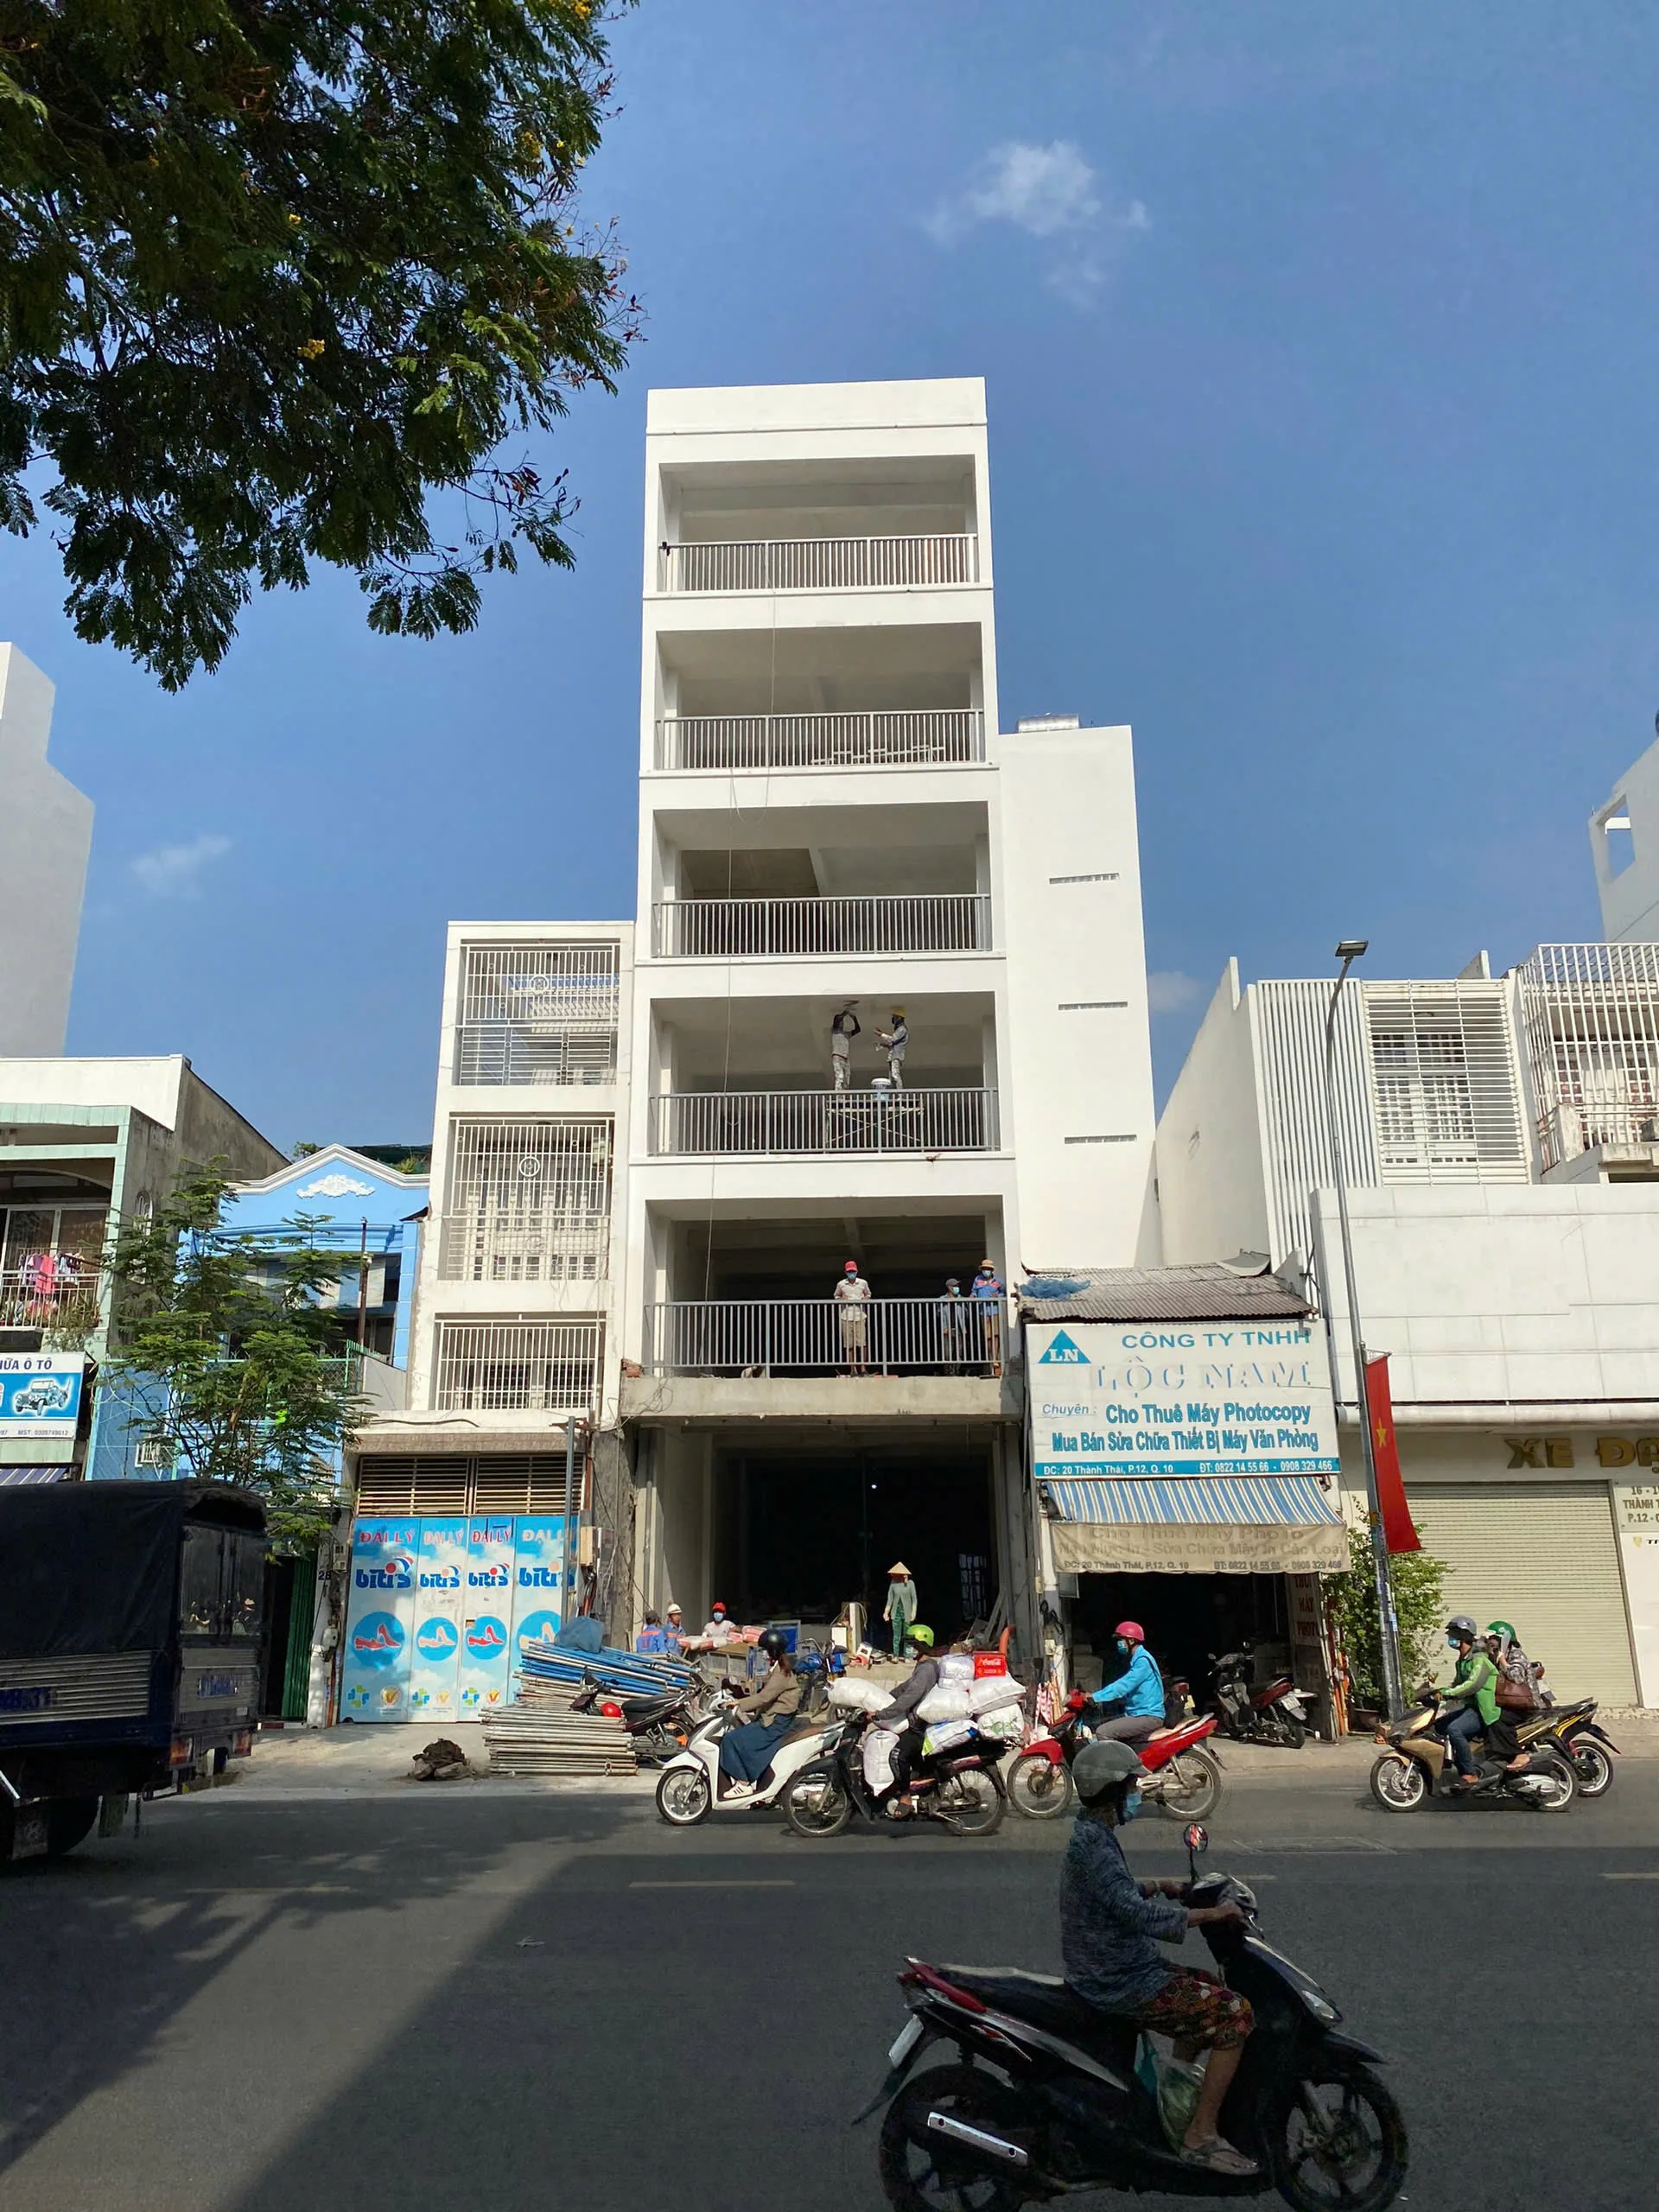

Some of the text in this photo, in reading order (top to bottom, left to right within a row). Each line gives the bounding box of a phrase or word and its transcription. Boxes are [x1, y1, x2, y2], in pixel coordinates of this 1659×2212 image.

[1122, 1331, 1311, 1348] CÔNG TY TNHH
[1048, 1348, 1079, 1362] LN
[24, 1357, 32, 1370] Ô
[37, 1357, 53, 1370] TÔ
[1042, 1403, 1089, 1416] Chuyên
[1106, 1402, 1311, 1427] Cho Thuê Máy Photocopy
[1052, 1427, 1319, 1453] Mua Bán Sửa Chữa Thiết Bị Máy Văn Phòng
[1504, 1438, 1574, 1469] XE
[1062, 1465, 1072, 1475] 20
[1075, 1464, 1103, 1474] Thành
[1163, 1464, 1173, 1473] 10
[1215, 1463, 1234, 1472] 0822
[1236, 1462, 1246, 1471] 14
[1248, 1462, 1257, 1471] 55
[1259, 1462, 1268, 1471] 66
[1281, 1461, 1299, 1471] 0908
[1301, 1460, 1316, 1471] 329
[1623, 1497, 1654, 1509] THÀNH
[1628, 1514, 1648, 1522] P.12
